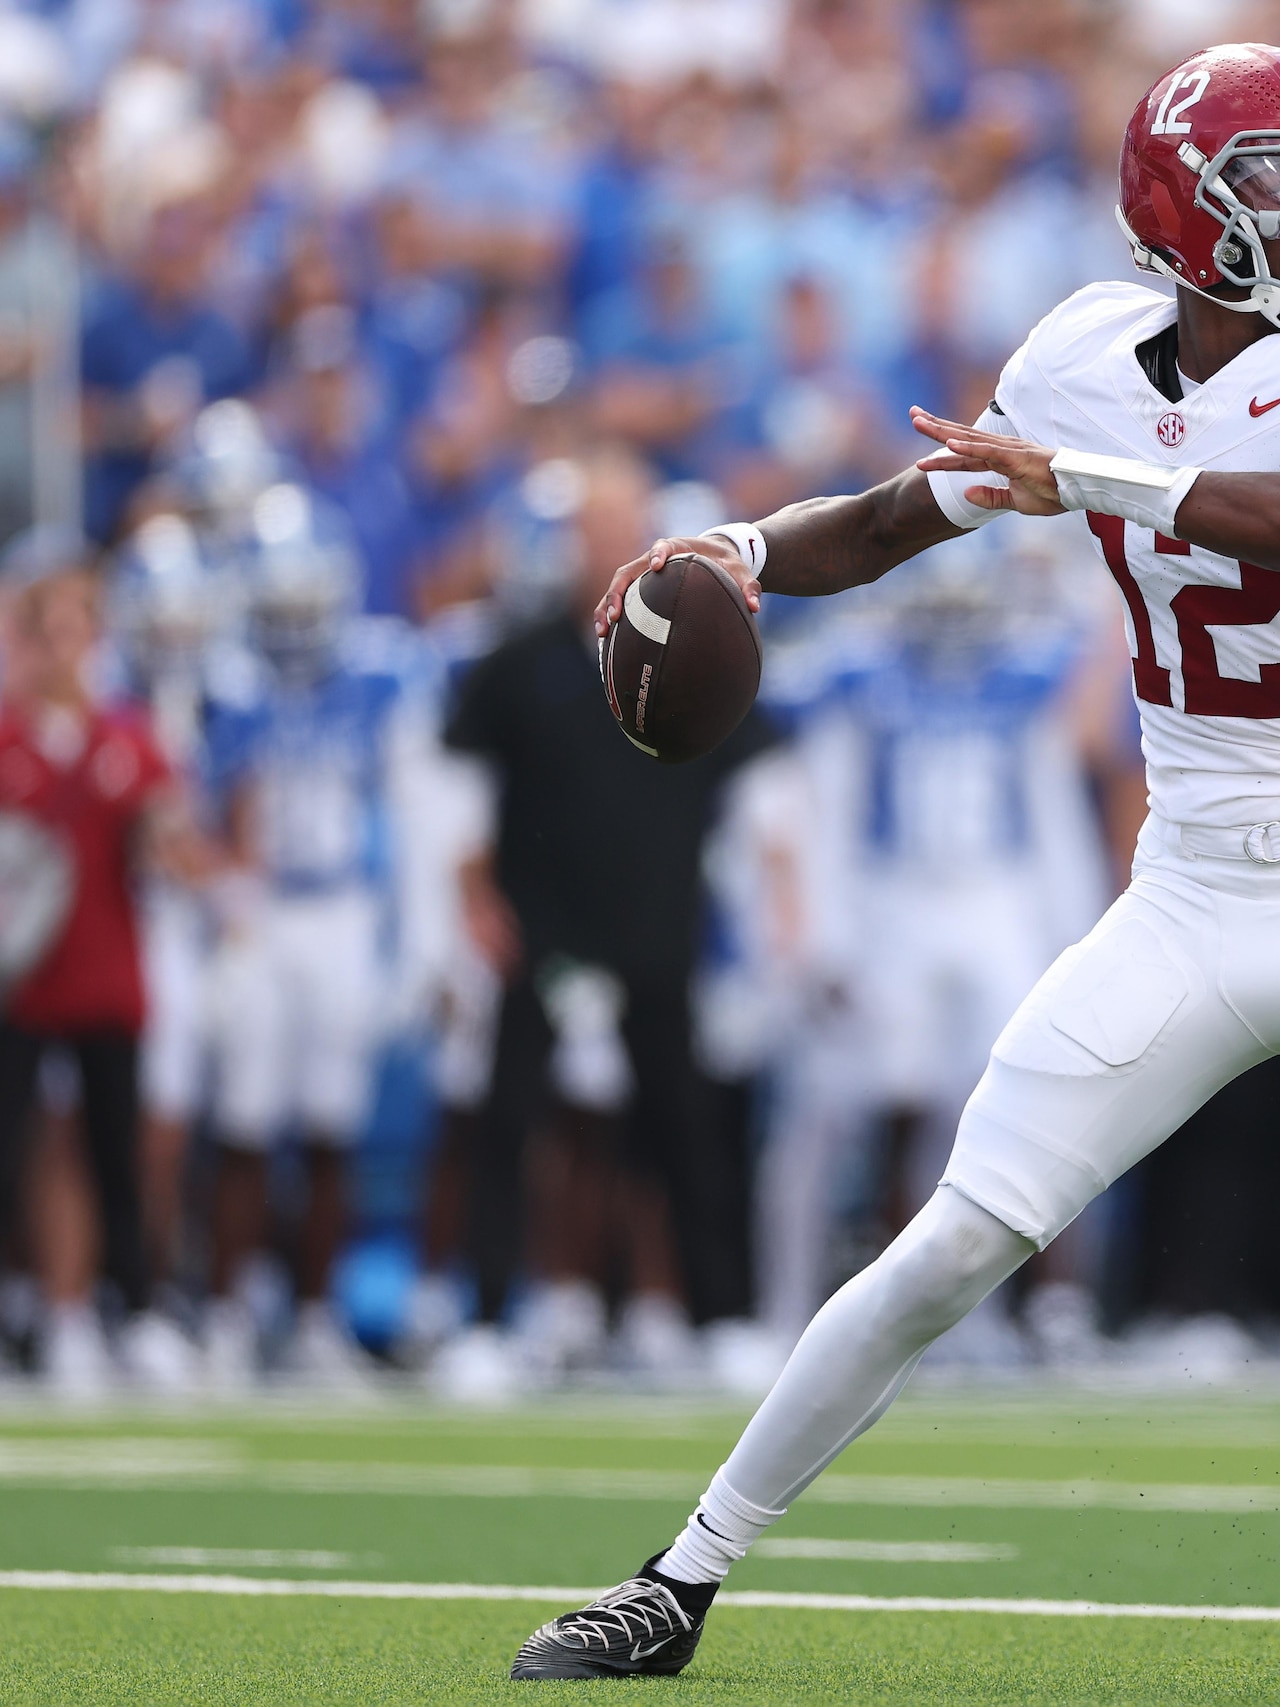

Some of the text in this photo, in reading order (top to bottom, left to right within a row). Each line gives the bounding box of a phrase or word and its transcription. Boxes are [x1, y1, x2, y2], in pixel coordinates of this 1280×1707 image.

[1150, 70, 1211, 135] 12
[1157, 413, 1184, 446] SEC
[638, 663, 652, 701] ELITE
